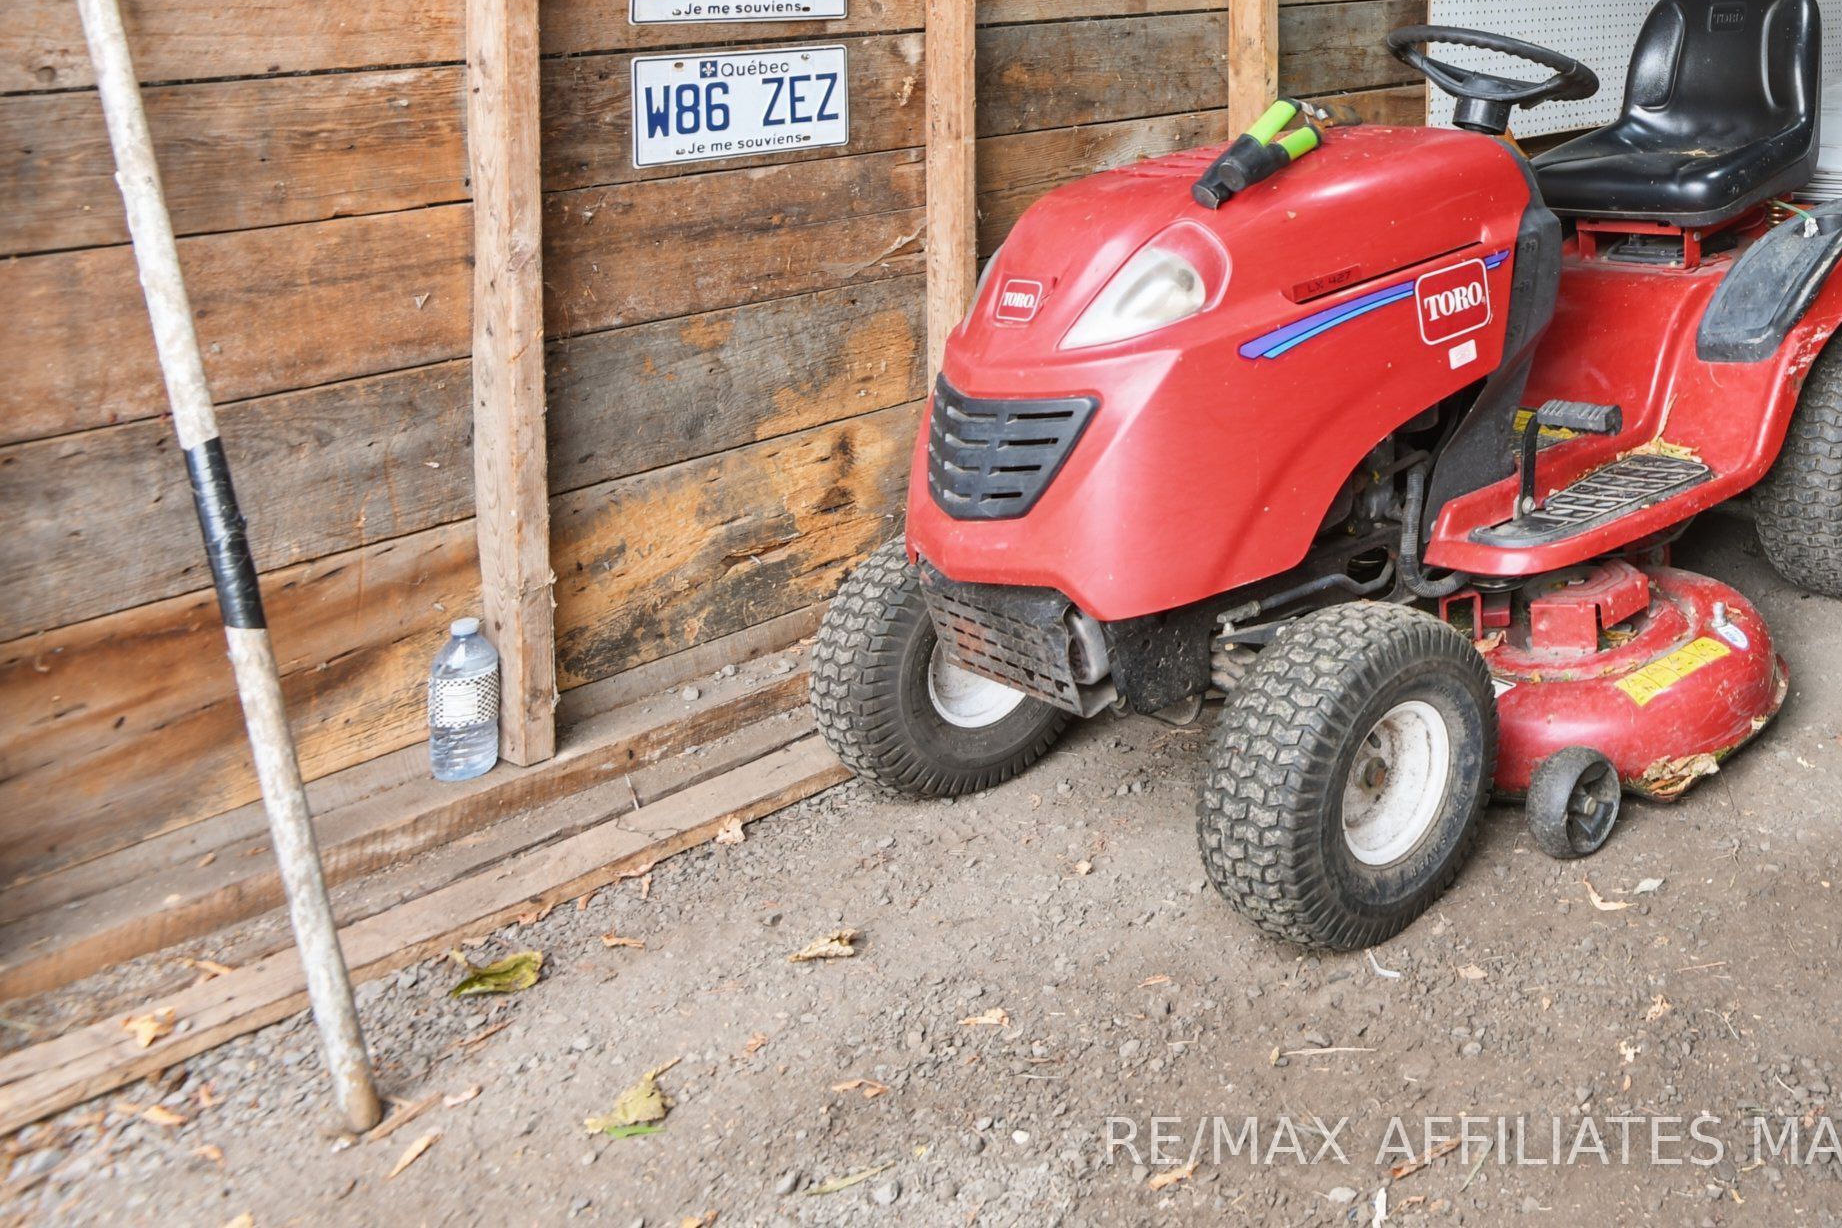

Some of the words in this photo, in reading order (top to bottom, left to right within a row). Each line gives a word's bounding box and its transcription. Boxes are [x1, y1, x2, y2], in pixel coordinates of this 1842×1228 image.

[684, 3, 702, 15] Je
[708, 3, 730, 14] me
[735, 0, 801, 13] souviens
[721, 60, 790, 77] Québec
[645, 81, 730, 139] W86
[762, 72, 839, 127] ZEZ
[688, 142, 705, 155] Je
[711, 140, 733, 151] me
[737, 133, 802, 149] souviens
[1307, 280, 1324, 293] LX
[1002, 291, 1035, 308] TORO
[1424, 281, 1483, 322] TORO
